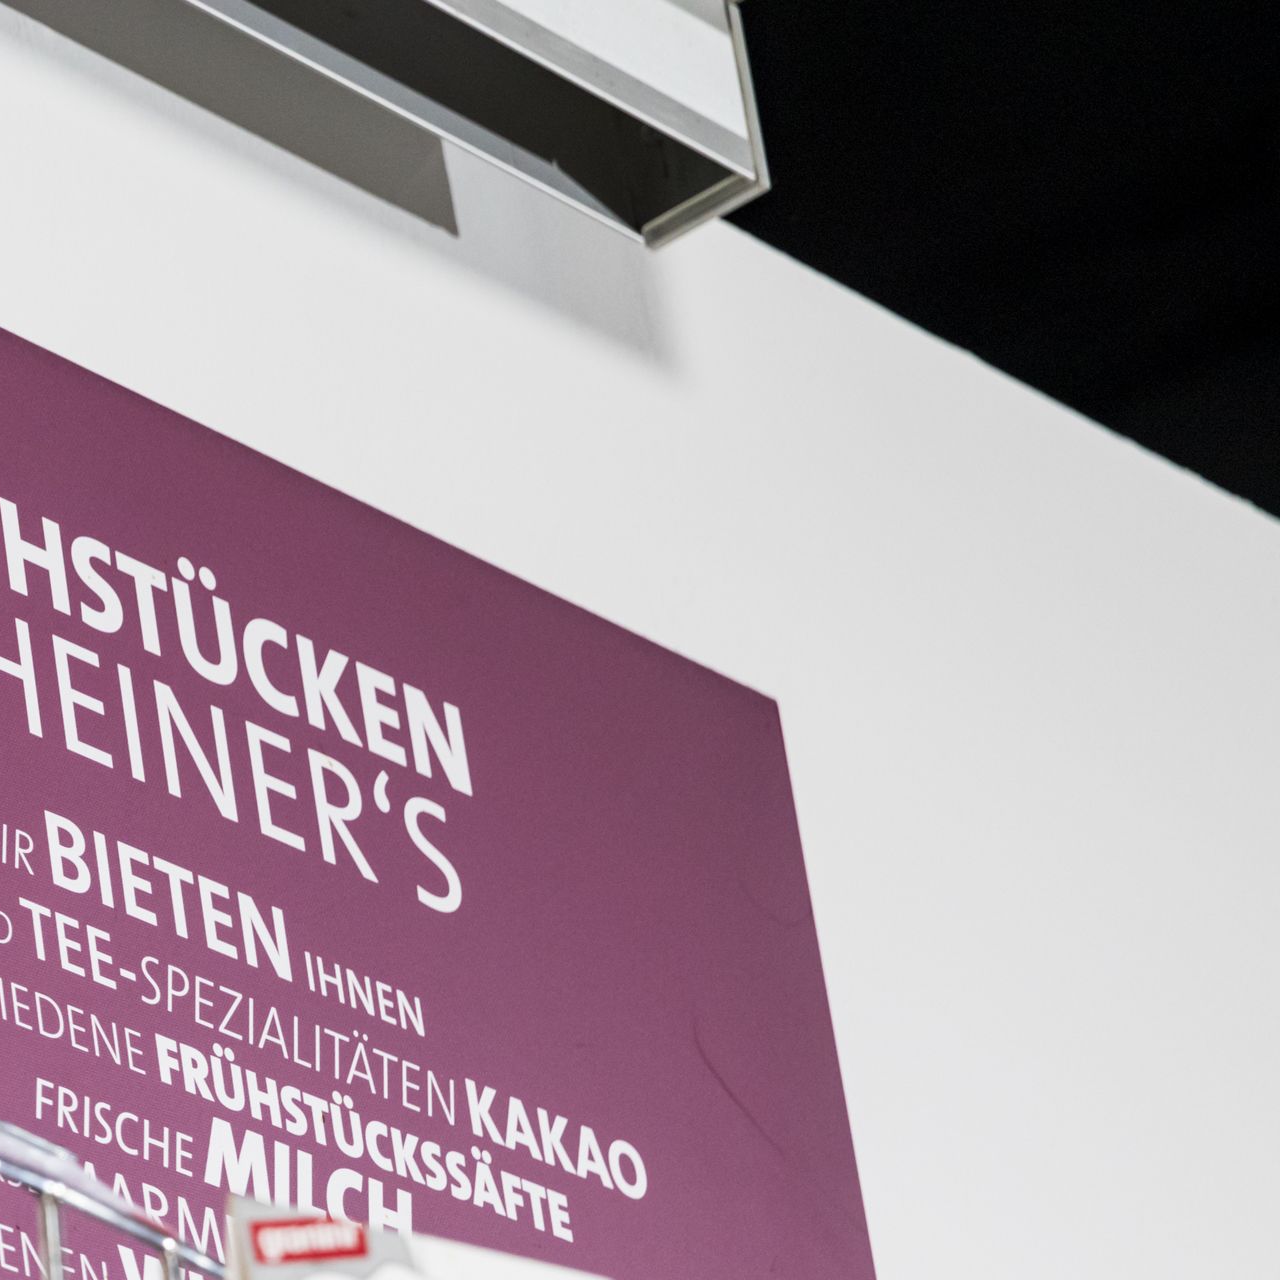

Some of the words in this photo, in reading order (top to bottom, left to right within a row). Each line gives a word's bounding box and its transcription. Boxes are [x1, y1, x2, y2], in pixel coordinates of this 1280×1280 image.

[43, 809, 293, 983] BIETEN
[304, 951, 426, 1037] IHNEN
[18, 896, 455, 1126] TEE-SPEZIALITÄTEN
[464, 1077, 648, 1200] KAKAO
[153, 1032, 574, 1243] FRÜHSTÜCKSSÄFTE
[35, 1077, 194, 1178] FRISCHE
[204, 1116, 413, 1240] MILCH
